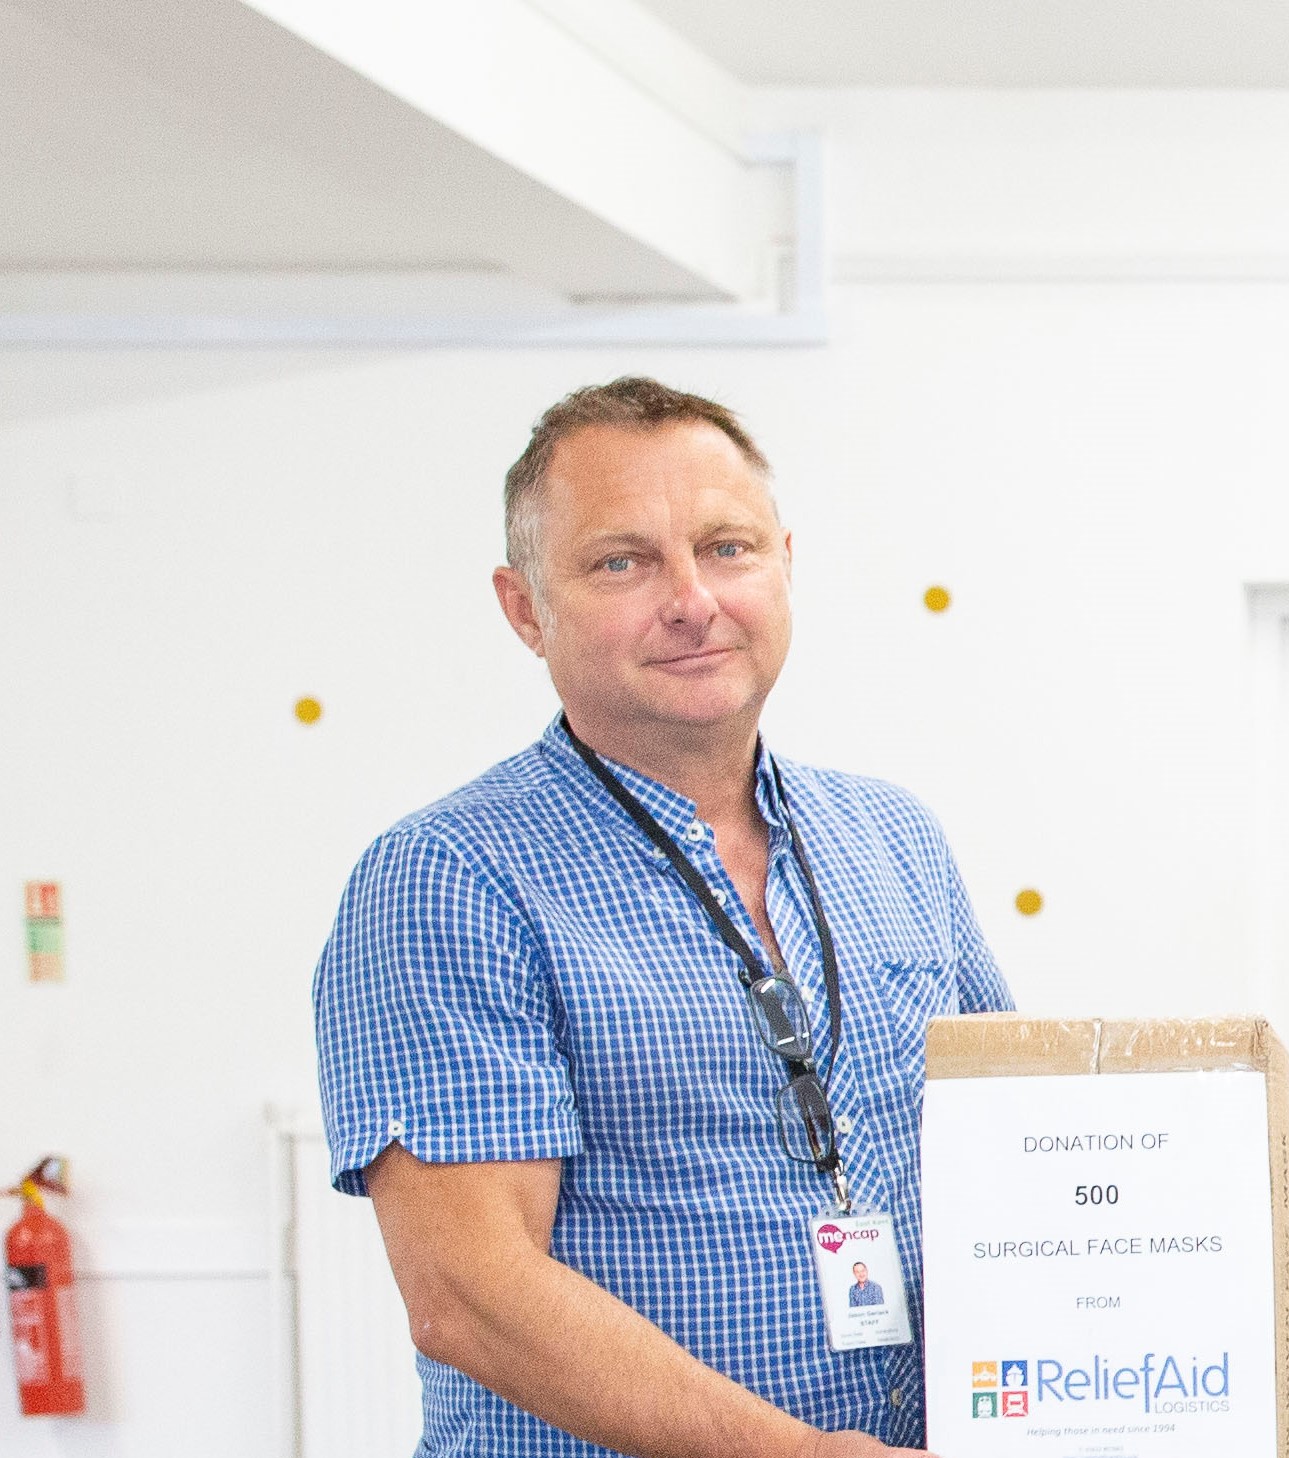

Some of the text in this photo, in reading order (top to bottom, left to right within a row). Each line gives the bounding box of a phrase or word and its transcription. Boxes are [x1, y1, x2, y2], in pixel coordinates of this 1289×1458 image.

[1023, 1133, 1169, 1153] DONATION OF
[1075, 1184, 1119, 1206] 500
[817, 1228, 879, 1244] mencap
[973, 1236, 1223, 1259] SURGICAL FACE MASKS
[1076, 1296, 1121, 1309] FROM
[1037, 1352, 1229, 1413] ReliefAid
[1154, 1400, 1230, 1414] LOGISTICS
[1027, 1423, 1176, 1437] Helping those in need since 1994
